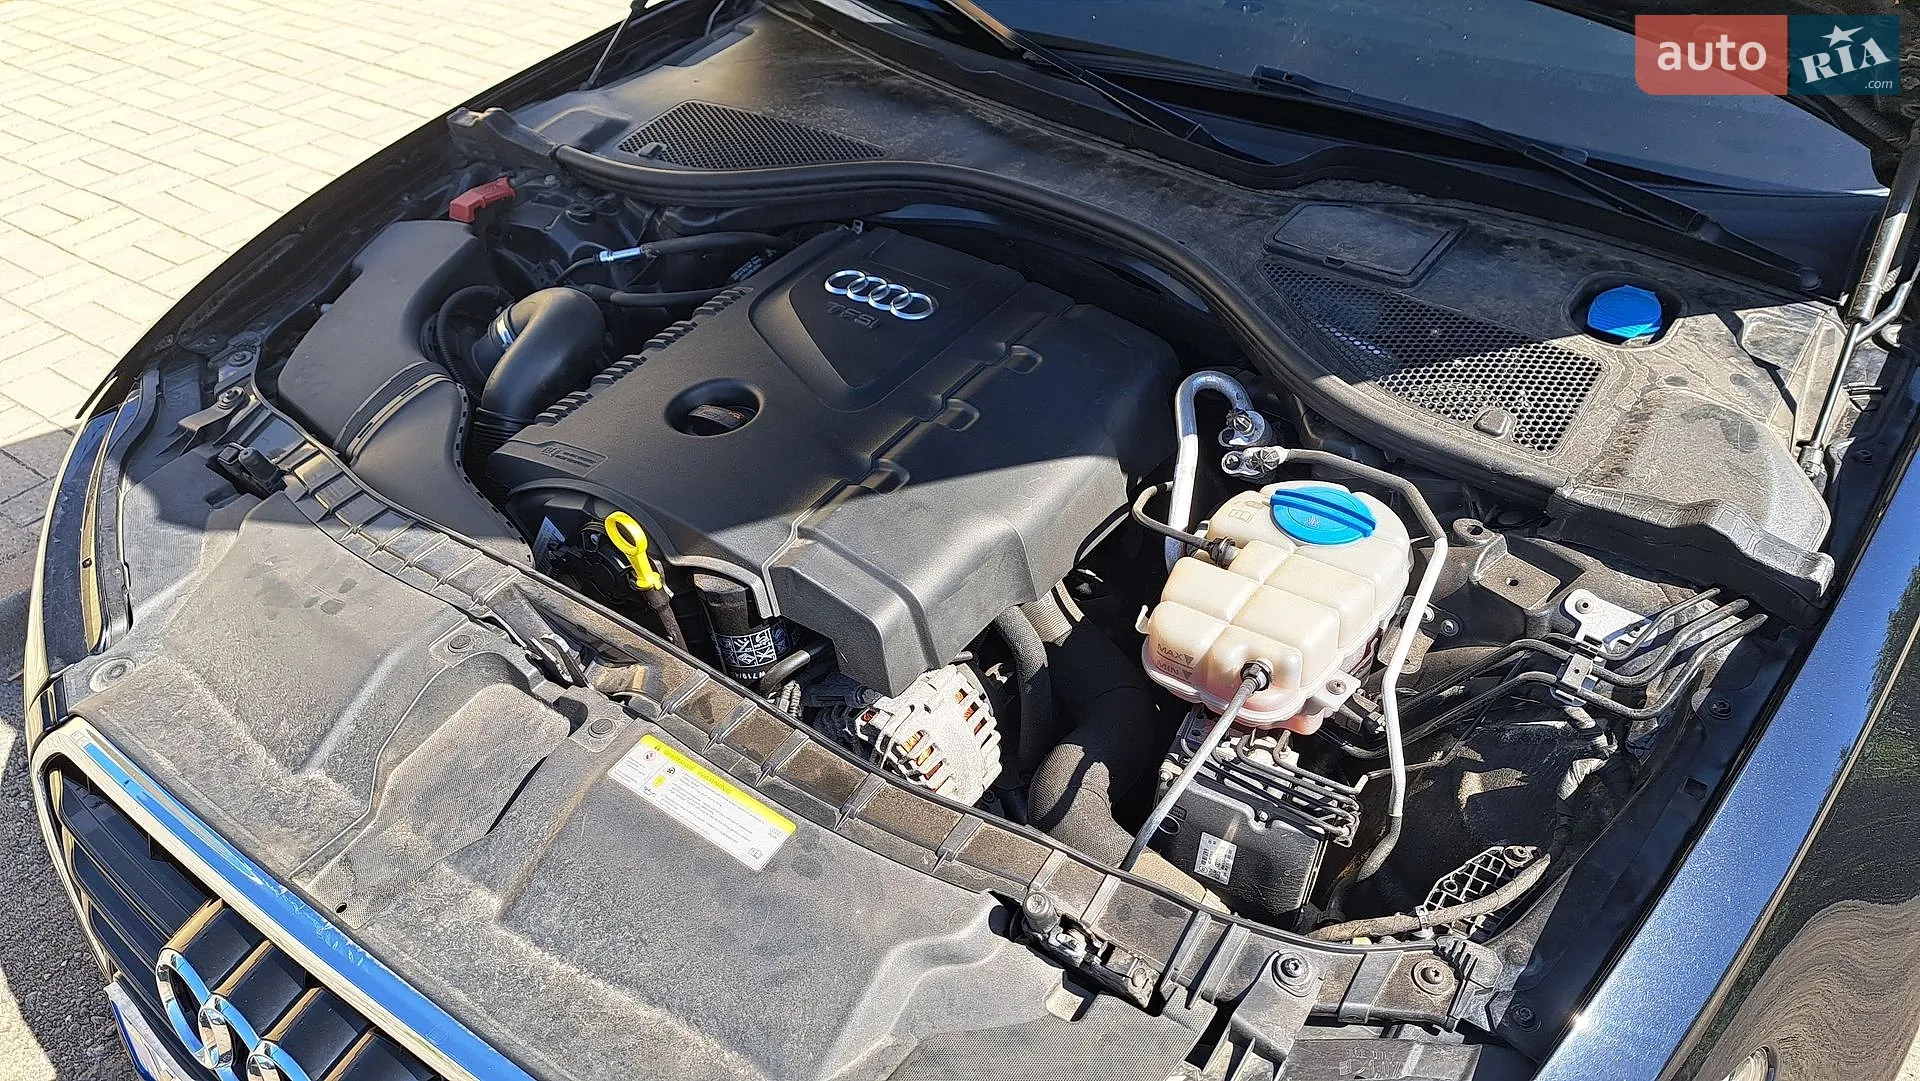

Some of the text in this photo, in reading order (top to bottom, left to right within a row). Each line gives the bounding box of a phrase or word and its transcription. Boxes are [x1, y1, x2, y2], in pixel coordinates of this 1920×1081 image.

[1158, 643, 1184, 660] MAX
[1158, 661, 1179, 675] MIN
[697, 770, 733, 795] WARNING
